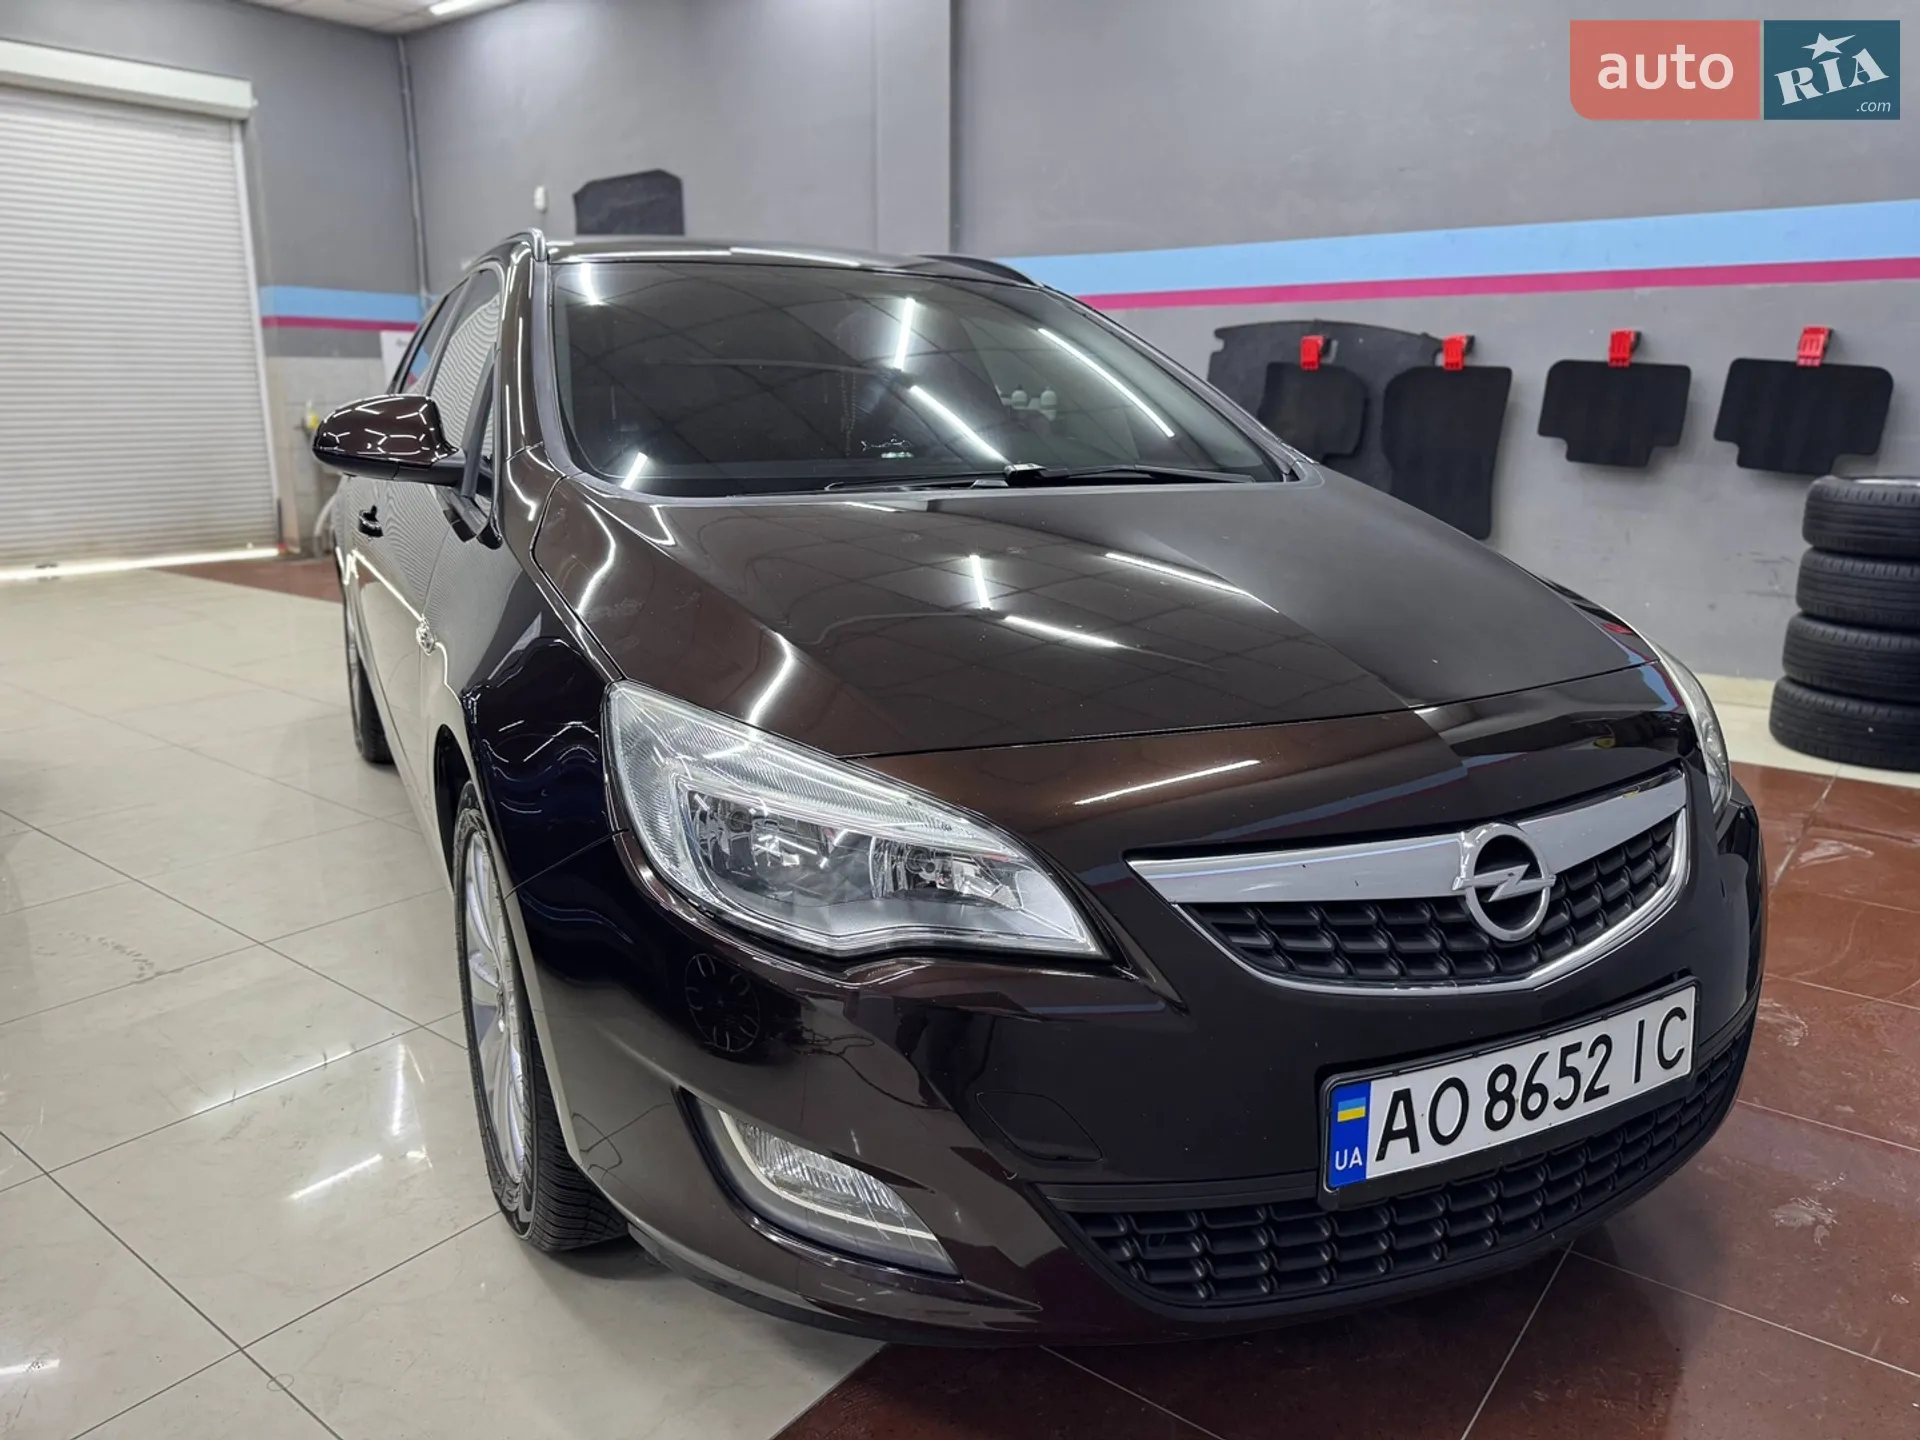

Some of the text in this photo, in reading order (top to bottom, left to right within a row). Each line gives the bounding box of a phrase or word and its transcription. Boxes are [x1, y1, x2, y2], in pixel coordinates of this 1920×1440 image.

[1375, 1006, 1687, 1162] AO 8652 IC
[1334, 1146, 1363, 1171] UA
